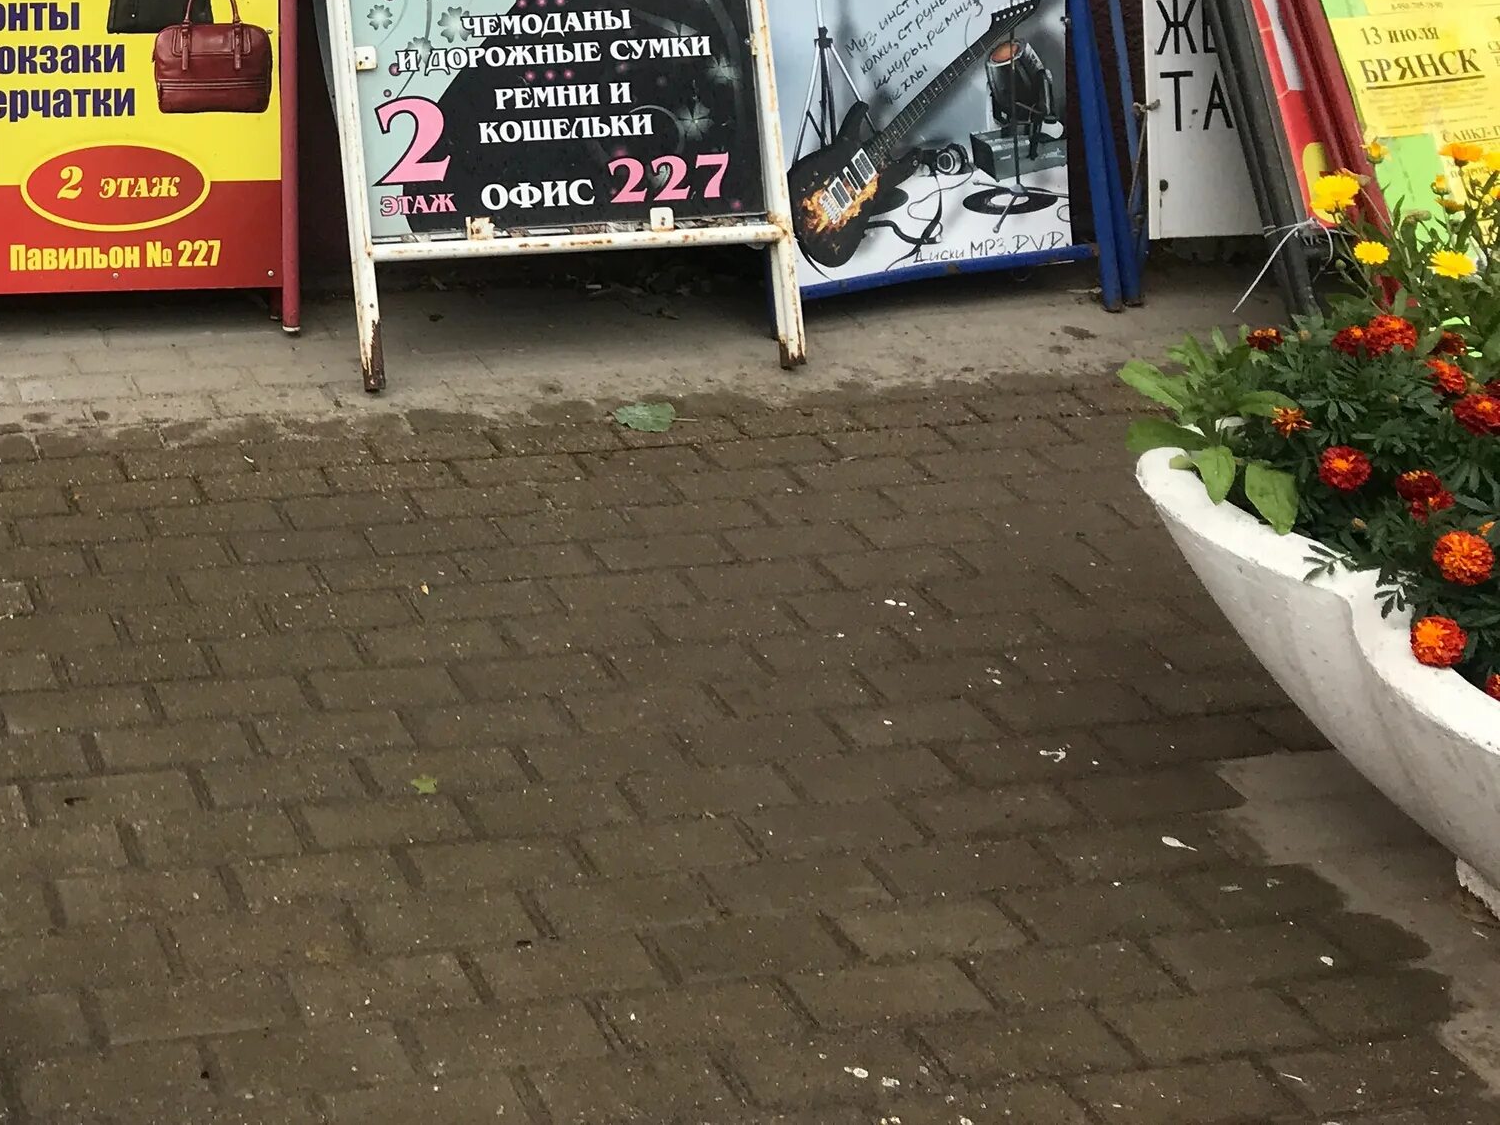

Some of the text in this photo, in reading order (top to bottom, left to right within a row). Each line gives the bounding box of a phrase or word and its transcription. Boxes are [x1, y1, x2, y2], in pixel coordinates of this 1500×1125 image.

[462, 9, 632, 39] ЧЕМОДАНЫ
[1360, 26, 1440, 45] 13 июля
[396, 35, 711, 75] И ДОРОЖНЫЕ СУМКИ
[1358, 48, 1482, 83] БРЯНСК
[494, 82, 631, 111] РЕМНИ И
[373, 96, 451, 187] 2
[479, 115, 653, 144] КОШЕЛЬКИ
[57, 165, 181, 200] 2 ЭТАЖ
[481, 151, 730, 211] ОФИС 227
[380, 192, 458, 217] ЭТАЖ
[10, 240, 221, 272] Павильон № 227
